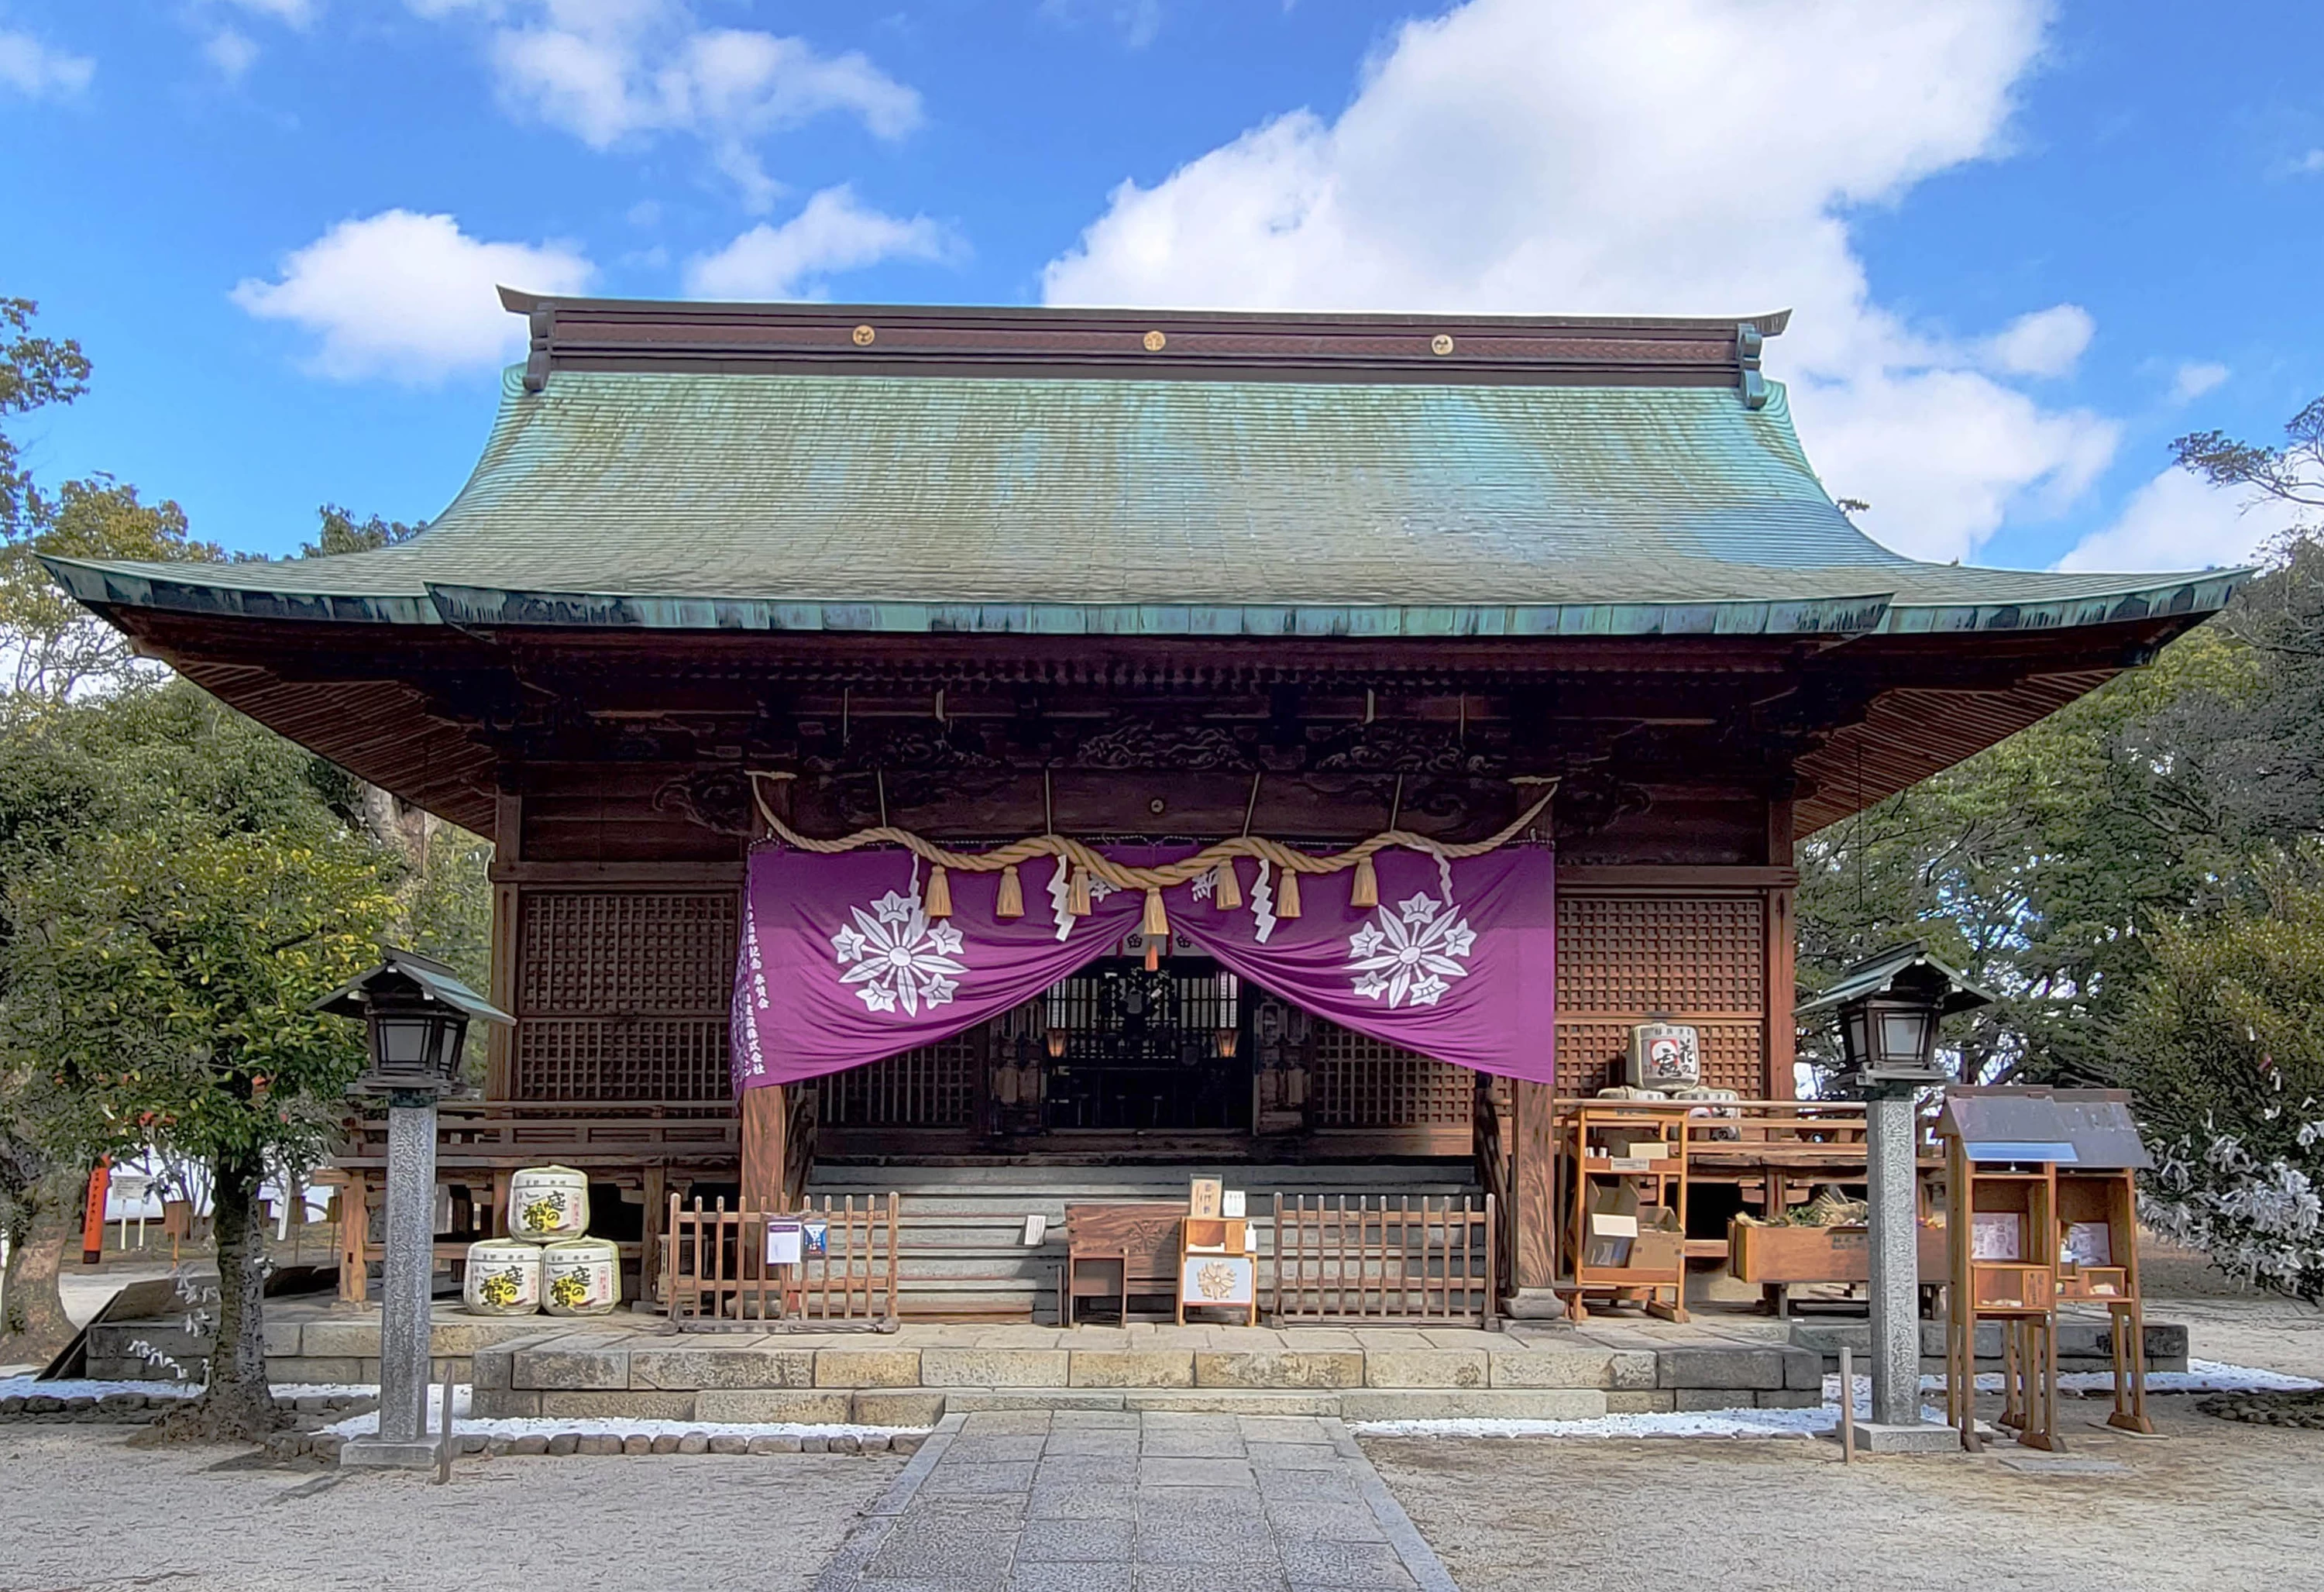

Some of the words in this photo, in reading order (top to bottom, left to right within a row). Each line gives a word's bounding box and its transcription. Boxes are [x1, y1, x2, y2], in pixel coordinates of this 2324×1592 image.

[544, 1191, 566, 1221] 庭の
[501, 1265, 524, 1295] 庭の
[569, 1266, 592, 1296] 庭の
